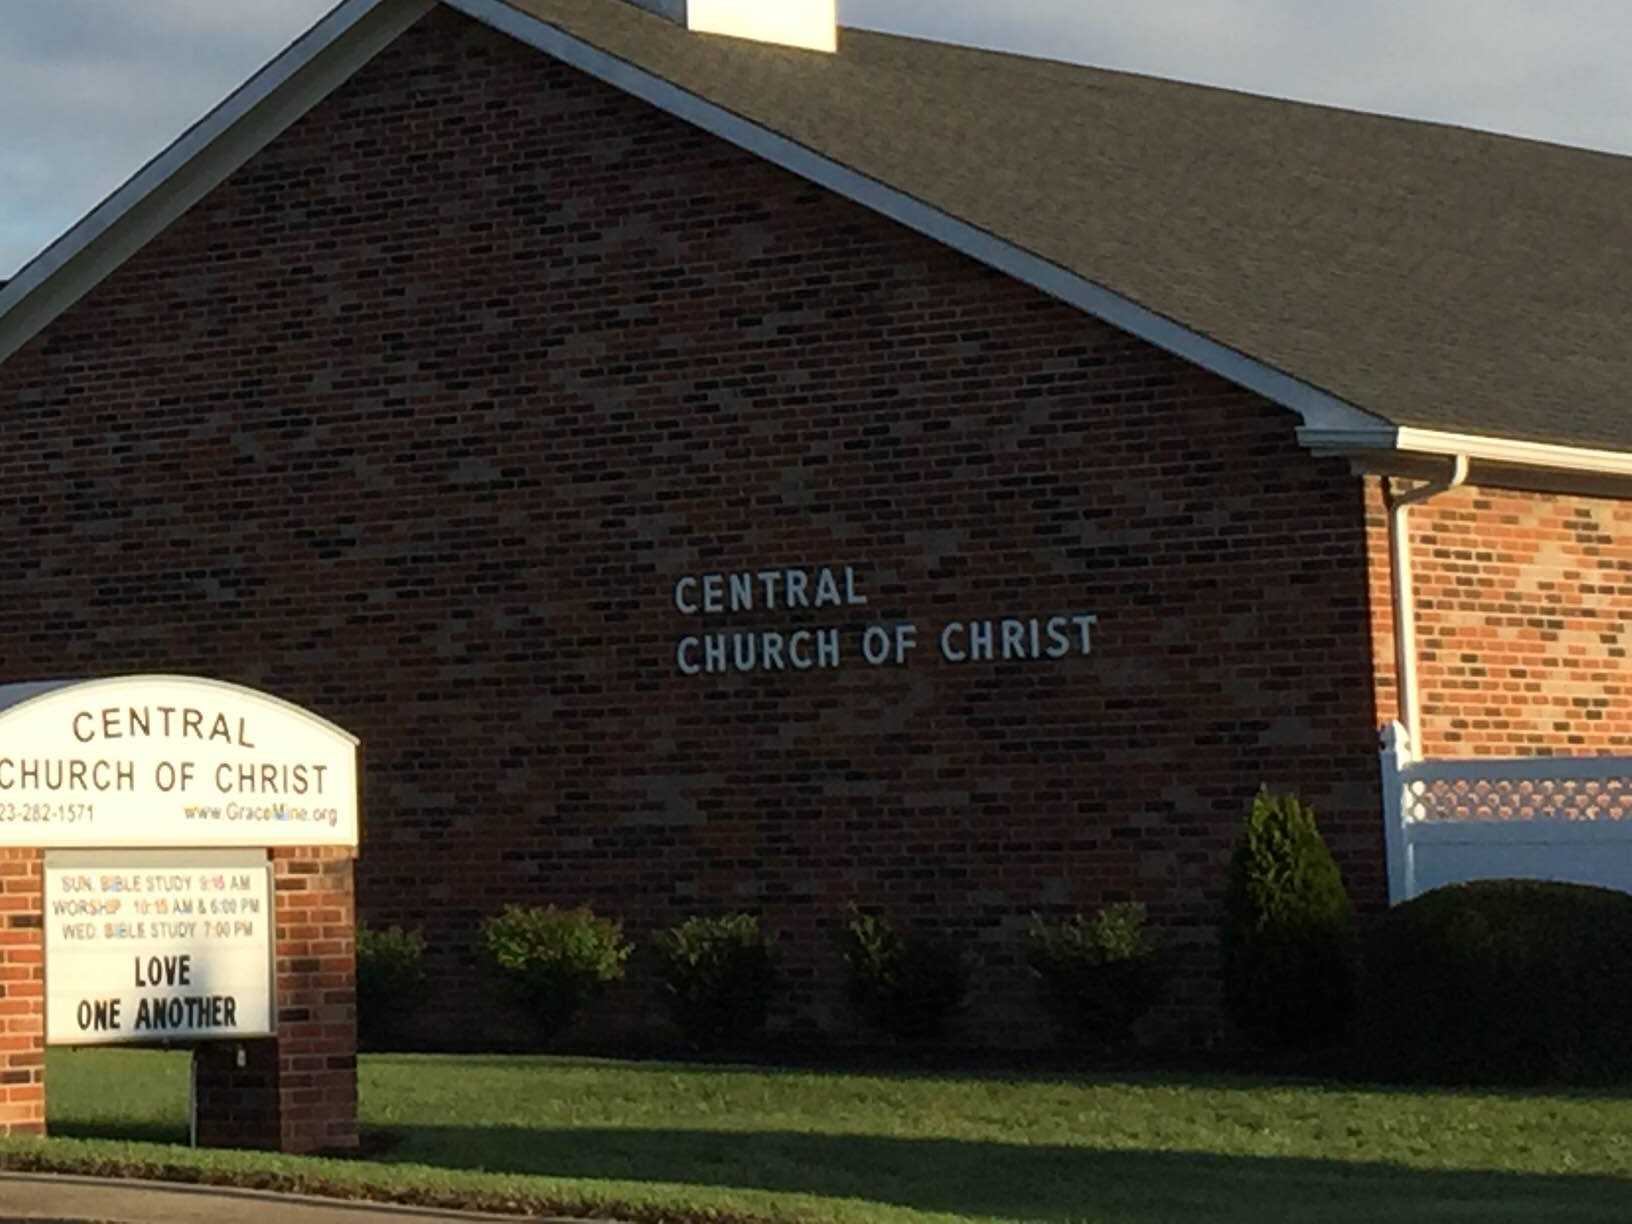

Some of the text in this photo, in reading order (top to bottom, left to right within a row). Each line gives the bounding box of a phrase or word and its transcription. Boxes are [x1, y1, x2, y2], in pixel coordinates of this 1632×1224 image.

[675, 567, 867, 614] CENTRAL
[676, 615, 1098, 674] CHURCH OF CHRIST
[72, 706, 256, 748] CENTRAL
[155, 761, 195, 792] OF
[215, 763, 328, 794] CHRIST
[100, 875, 142, 892] BIBLE
[146, 875, 192, 892] STUDY
[230, 875, 251, 891] AM
[52, 898, 121, 916] WORSHIP
[173, 898, 193, 914] AM
[198, 898, 207, 914] &
[240, 897, 260, 914] PM
[104, 922, 145, 939] BIBLE
[150, 921, 197, 938] STUDY
[234, 919, 253, 936] PM
[135, 955, 191, 987] LOVE
[77, 995, 237, 1030] ONE ANOTHER
